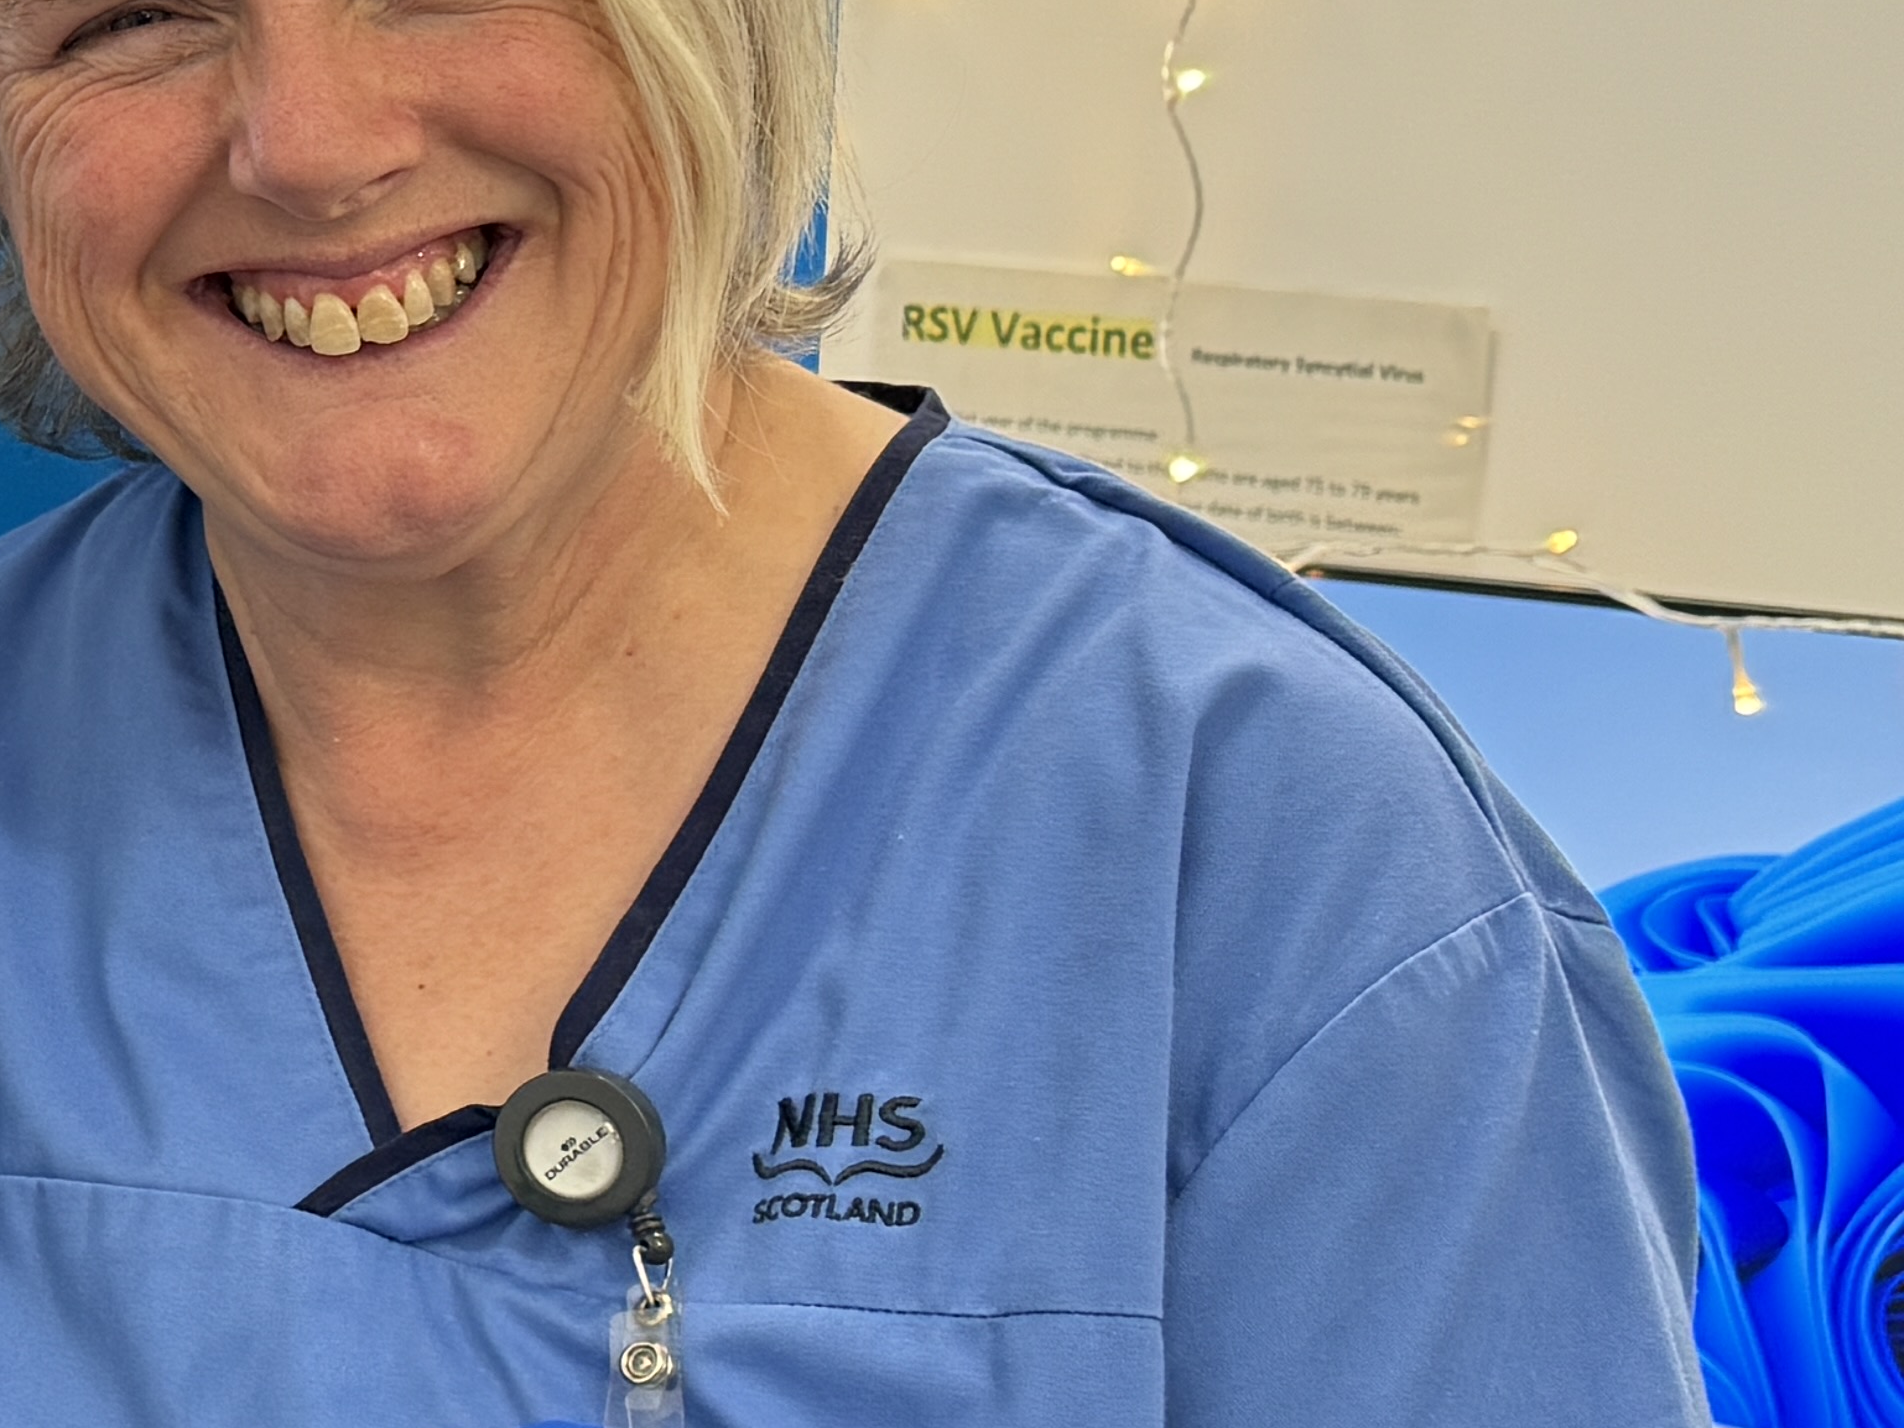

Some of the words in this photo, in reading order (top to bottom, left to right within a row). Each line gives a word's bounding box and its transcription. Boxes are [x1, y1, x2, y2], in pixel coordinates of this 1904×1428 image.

[902, 303, 978, 346] RSV
[991, 310, 1155, 360] Vaccine
[769, 1092, 926, 1155] NHS
[544, 1124, 610, 1181] DURABLE
[752, 1192, 922, 1228] SCOTLAND
